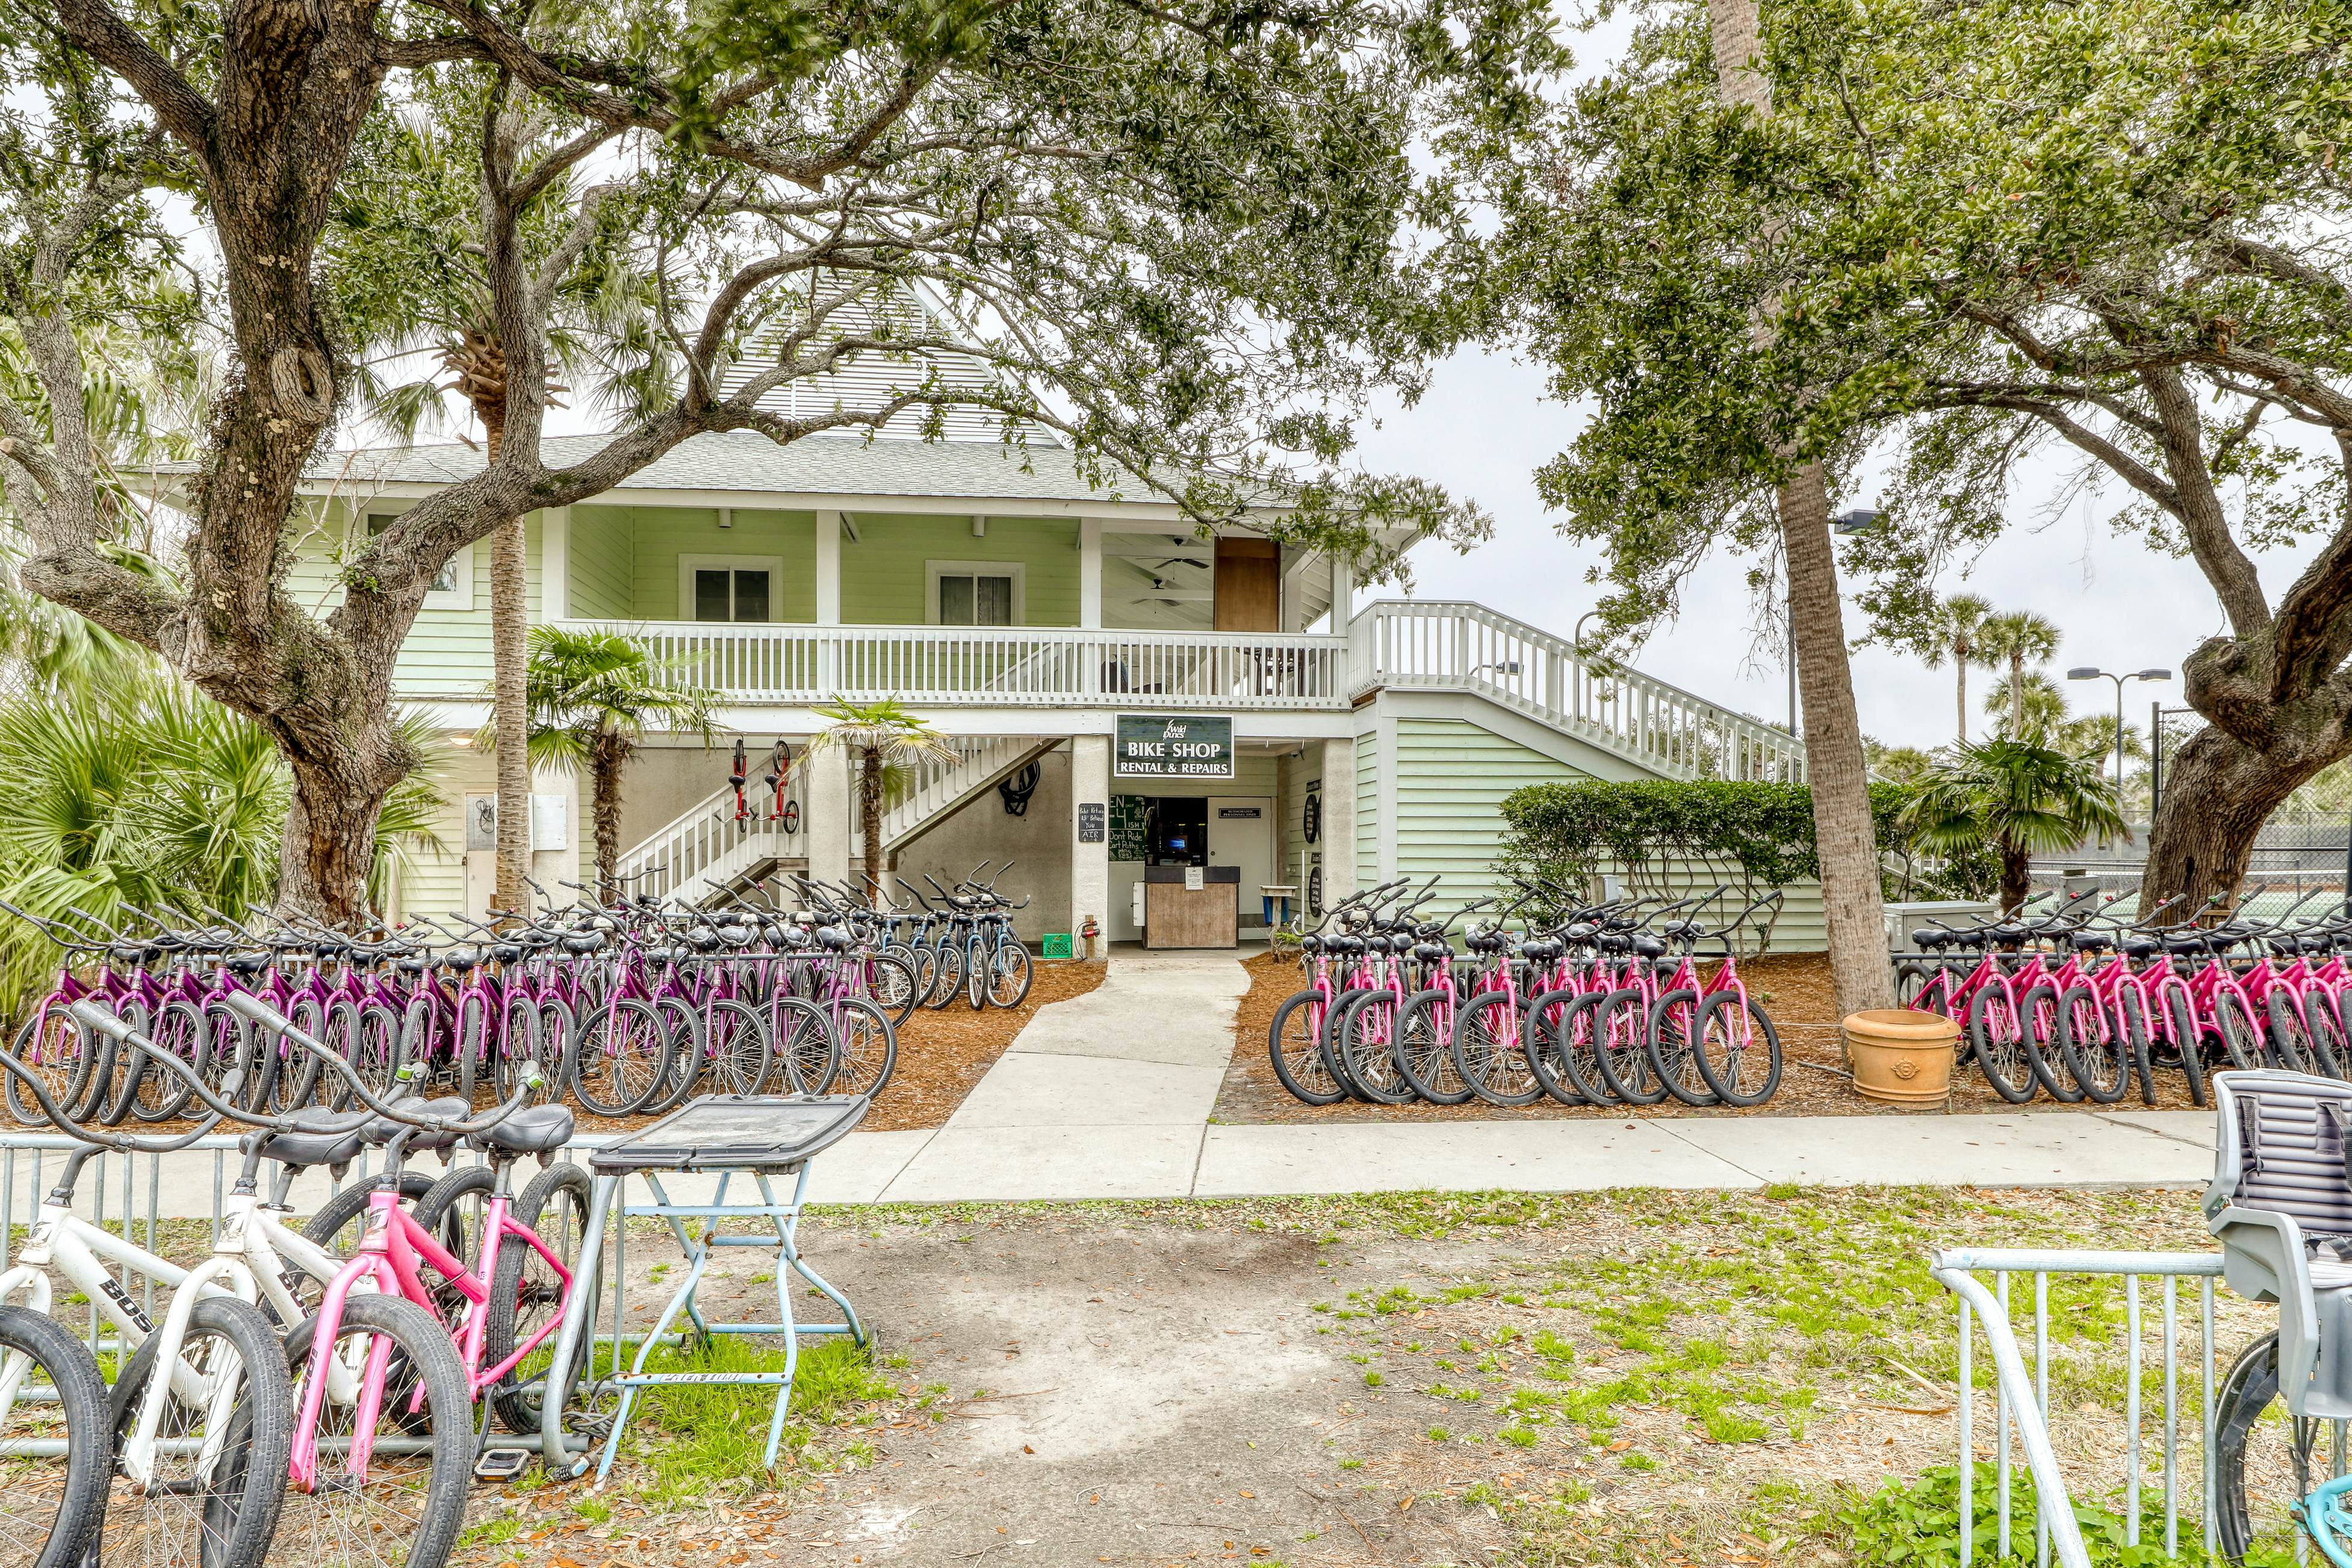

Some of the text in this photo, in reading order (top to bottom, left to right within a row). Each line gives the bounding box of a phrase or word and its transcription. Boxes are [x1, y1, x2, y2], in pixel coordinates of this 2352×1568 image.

[1128, 742, 1220, 758] BIKE SHOP
[1120, 762, 1228, 773] RENTAL & REPAIRS
[1128, 831, 1143, 841] Ride
[1122, 840, 1139, 849] Paths
[98, 1278, 155, 1337] BOS
